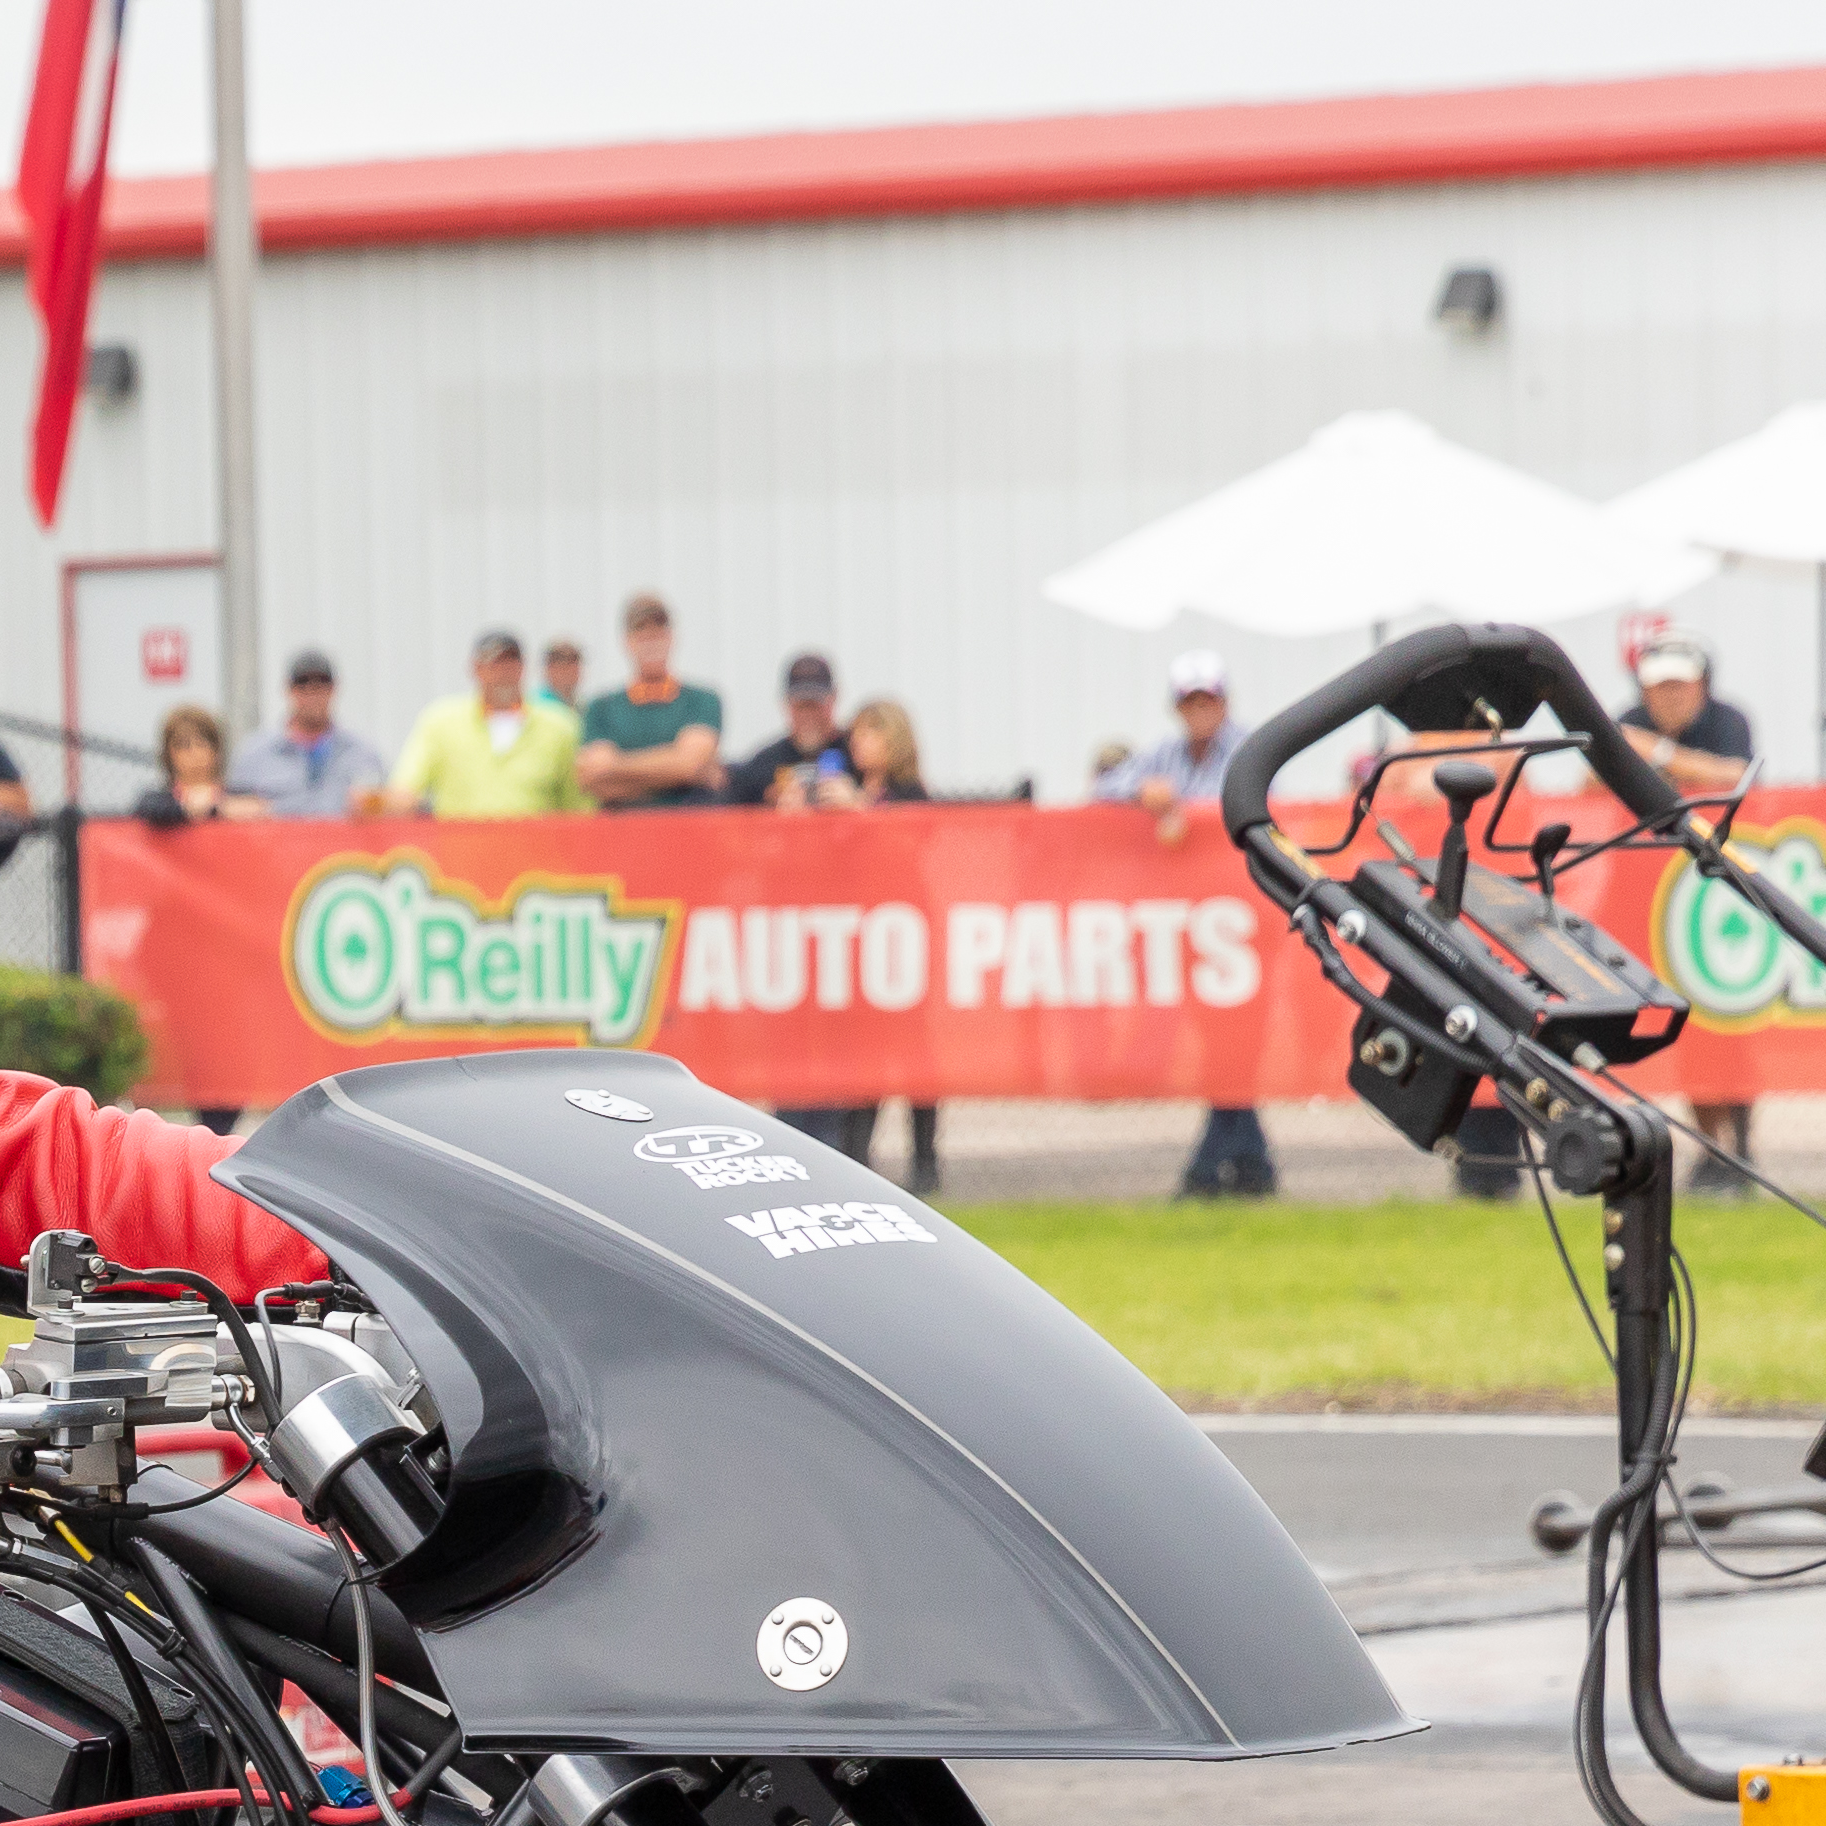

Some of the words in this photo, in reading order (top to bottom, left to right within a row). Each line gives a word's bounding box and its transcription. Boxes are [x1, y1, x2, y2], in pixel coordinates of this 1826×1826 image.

[314, 886, 649, 1024] O'Reilly
[679, 905, 929, 1012] AUTO
[952, 897, 1260, 1010] PARTS
[671, 1155, 800, 1177] TUCKER
[689, 1165, 811, 1190] ROCKY
[723, 1201, 917, 1238] VANCE
[757, 1222, 939, 1260] HINES
